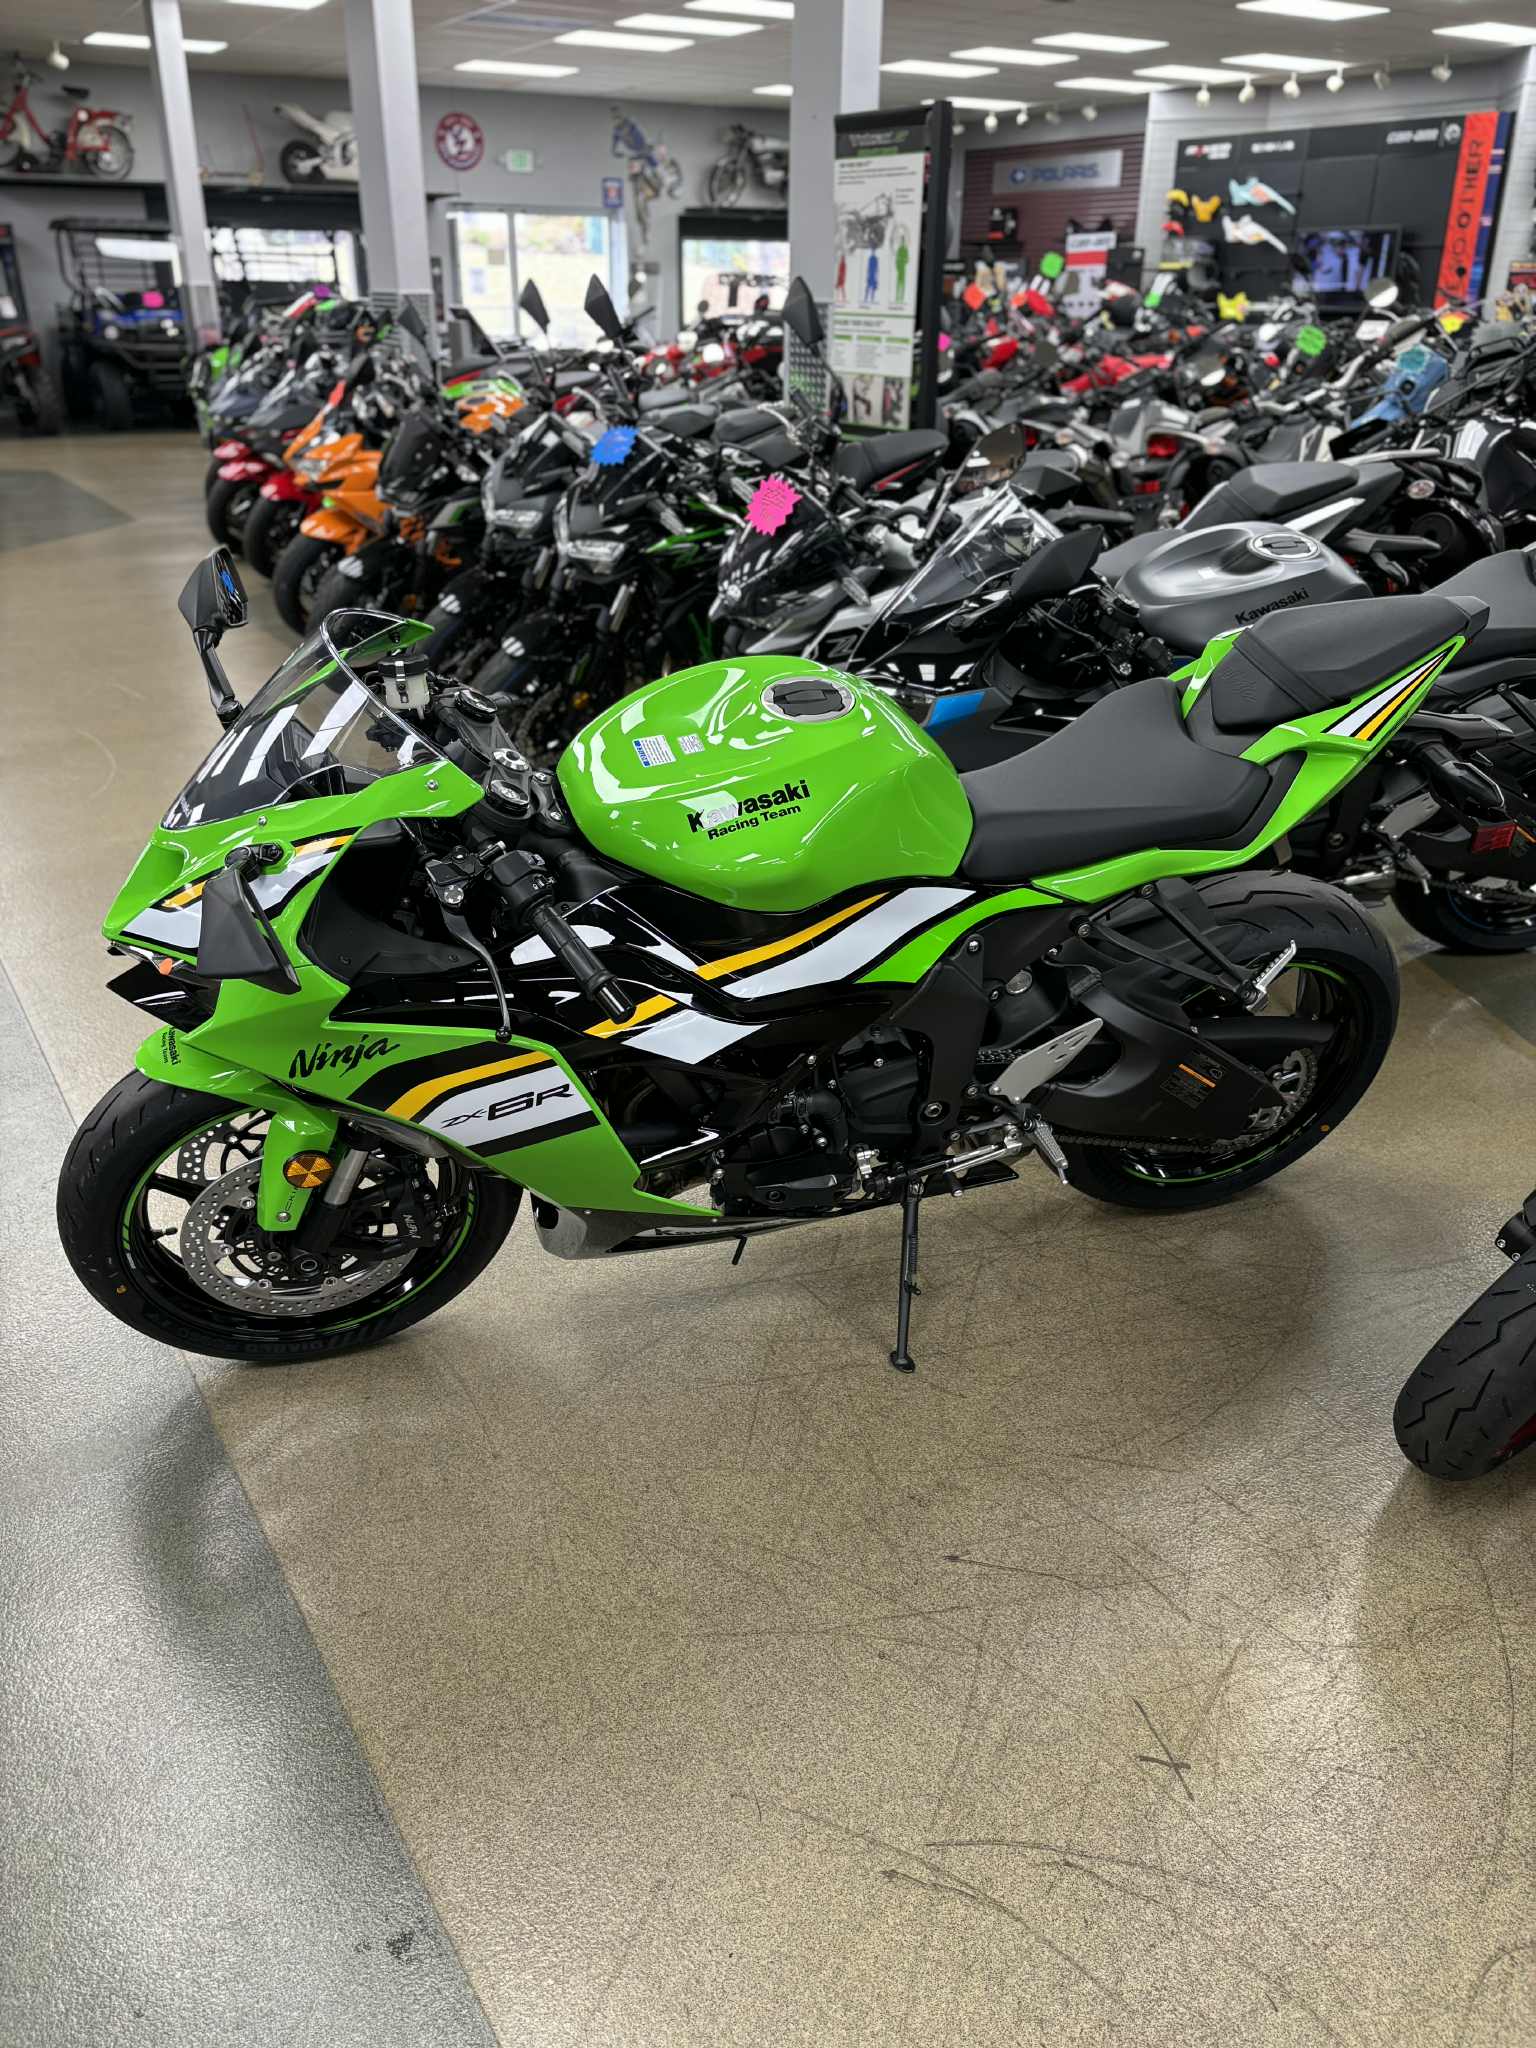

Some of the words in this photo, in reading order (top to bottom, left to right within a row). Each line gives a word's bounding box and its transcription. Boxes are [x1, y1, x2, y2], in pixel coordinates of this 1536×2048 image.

[1030, 163, 1099, 183] POLARIS
[1234, 587, 1310, 625] Kawasaki
[687, 779, 811, 833] Kawasaki
[707, 816, 760, 840] Racing
[760, 804, 801, 822] Team
[288, 1033, 401, 1079] Ninja
[440, 1083, 574, 1130] ZX-6R
